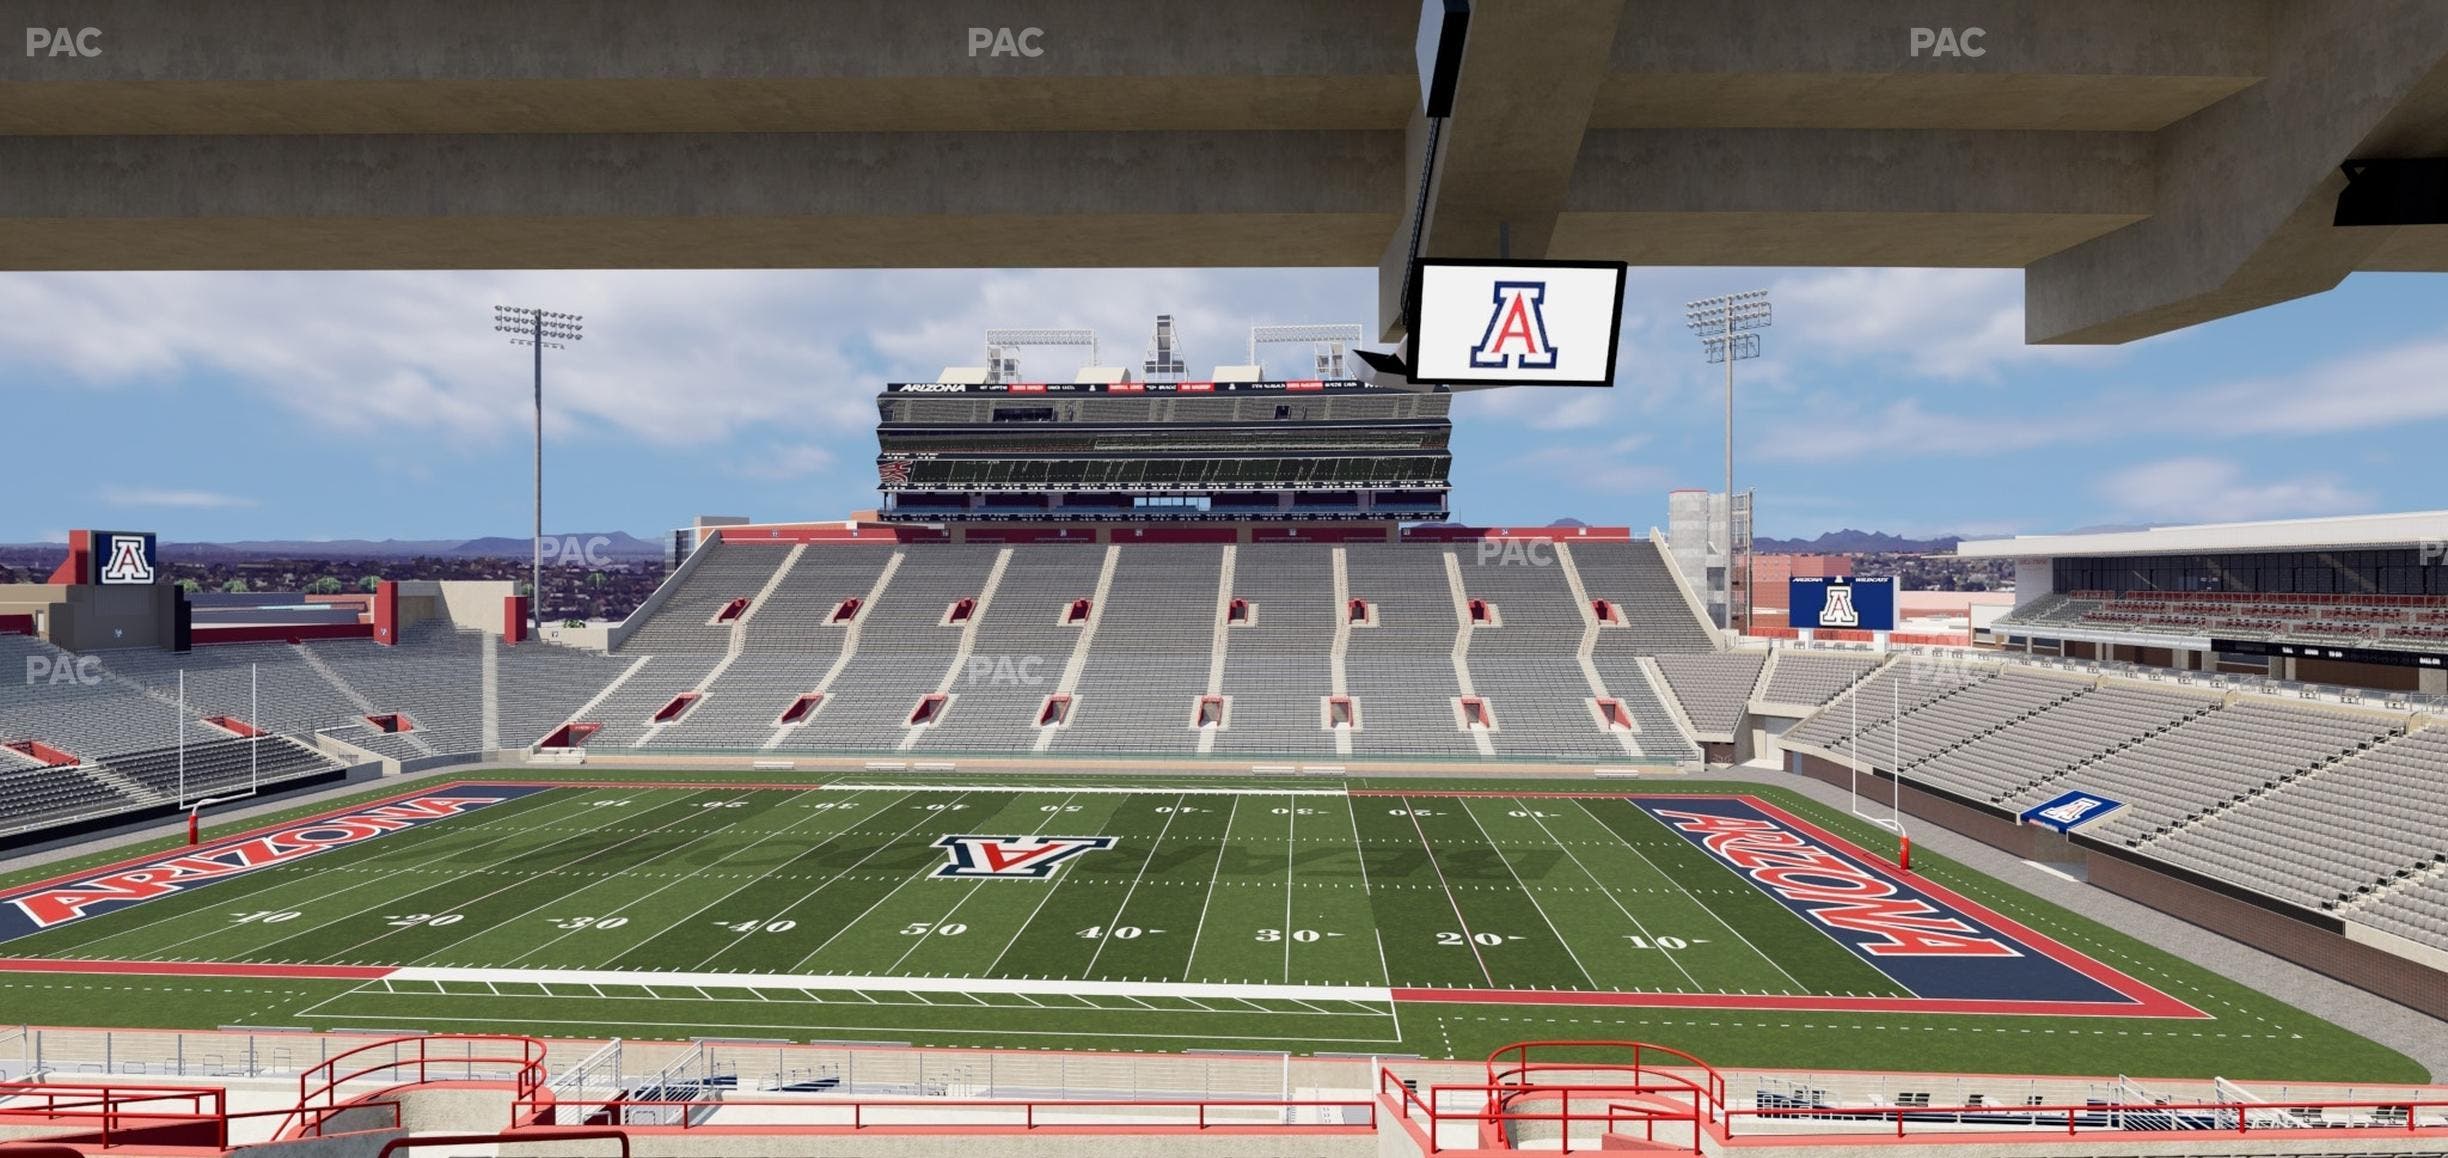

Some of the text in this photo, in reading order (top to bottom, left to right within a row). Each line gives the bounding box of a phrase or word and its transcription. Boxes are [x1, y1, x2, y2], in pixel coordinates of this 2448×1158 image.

[1470, 281, 1558, 369] A
[899, 383, 966, 392] ARIZONA
[101, 535, 154, 584] A
[1819, 585, 1858, 626] A
[3, 798, 507, 928] ARIZONA
[1652, 808, 2026, 957] ARIZONA
[229, 910, 302, 924] 10
[387, 913, 464, 927] 20
[556, 916, 629, 929] 30
[726, 919, 797, 933] 40
[900, 922, 968, 936] 50
[1075, 926, 1143, 940] 40
[1254, 928, 1322, 943] 30
[1436, 932, 1503, 947] 20
[1622, 935, 1689, 950] 10
